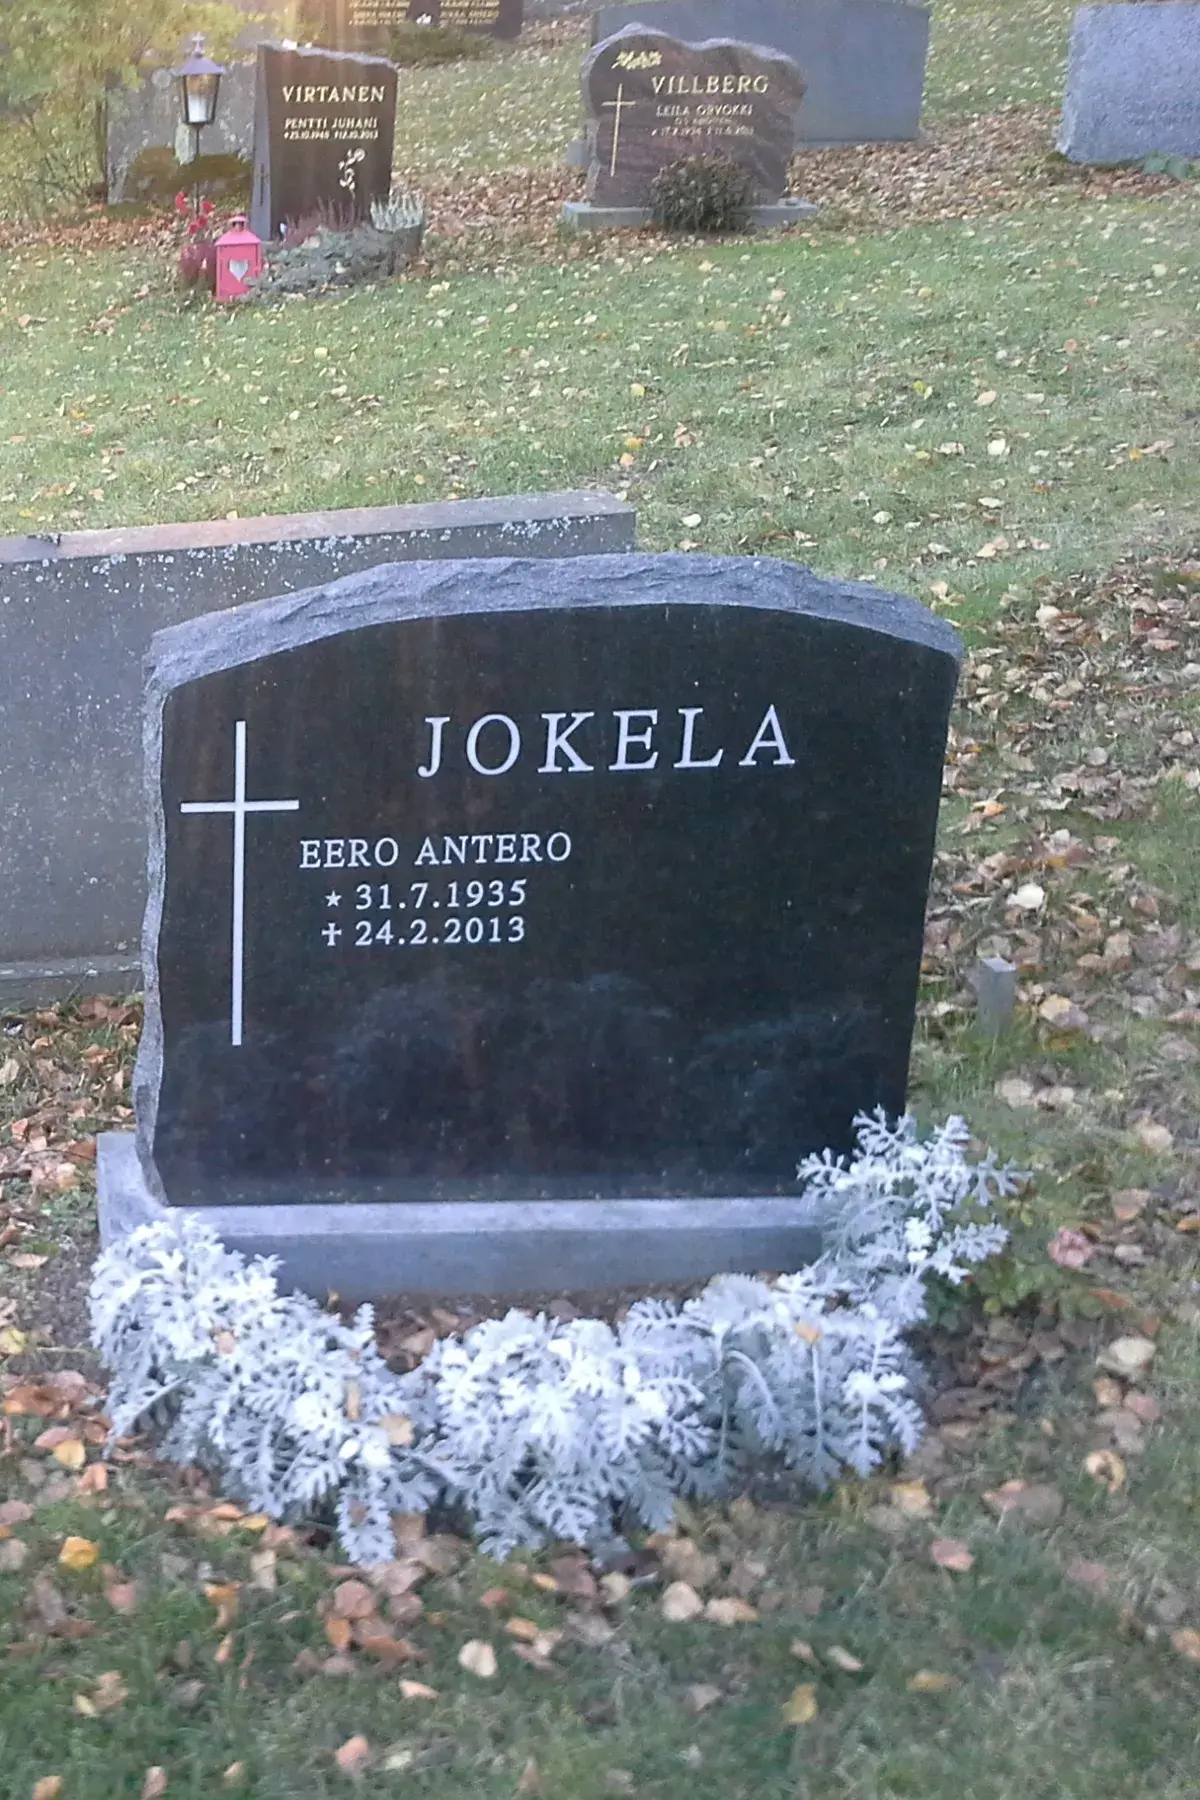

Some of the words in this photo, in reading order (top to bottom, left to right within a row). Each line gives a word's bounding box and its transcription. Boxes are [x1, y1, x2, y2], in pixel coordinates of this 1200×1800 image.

[282, 85, 386, 103] VIRTANEN
[651, 75, 769, 94] VILLBERG
[284, 117, 327, 129] PENTTI
[332, 117, 378, 129] JUHANI
[656, 105, 690, 117] LEILA
[696, 104, 753, 116] ORVOKKI
[417, 704, 796, 779] JOKELA
[300, 837, 400, 869] EERO
[414, 832, 572, 867] ANTERO
[355, 879, 528, 910] 31.7.1935
[355, 916, 526, 947] 24.2.2013
